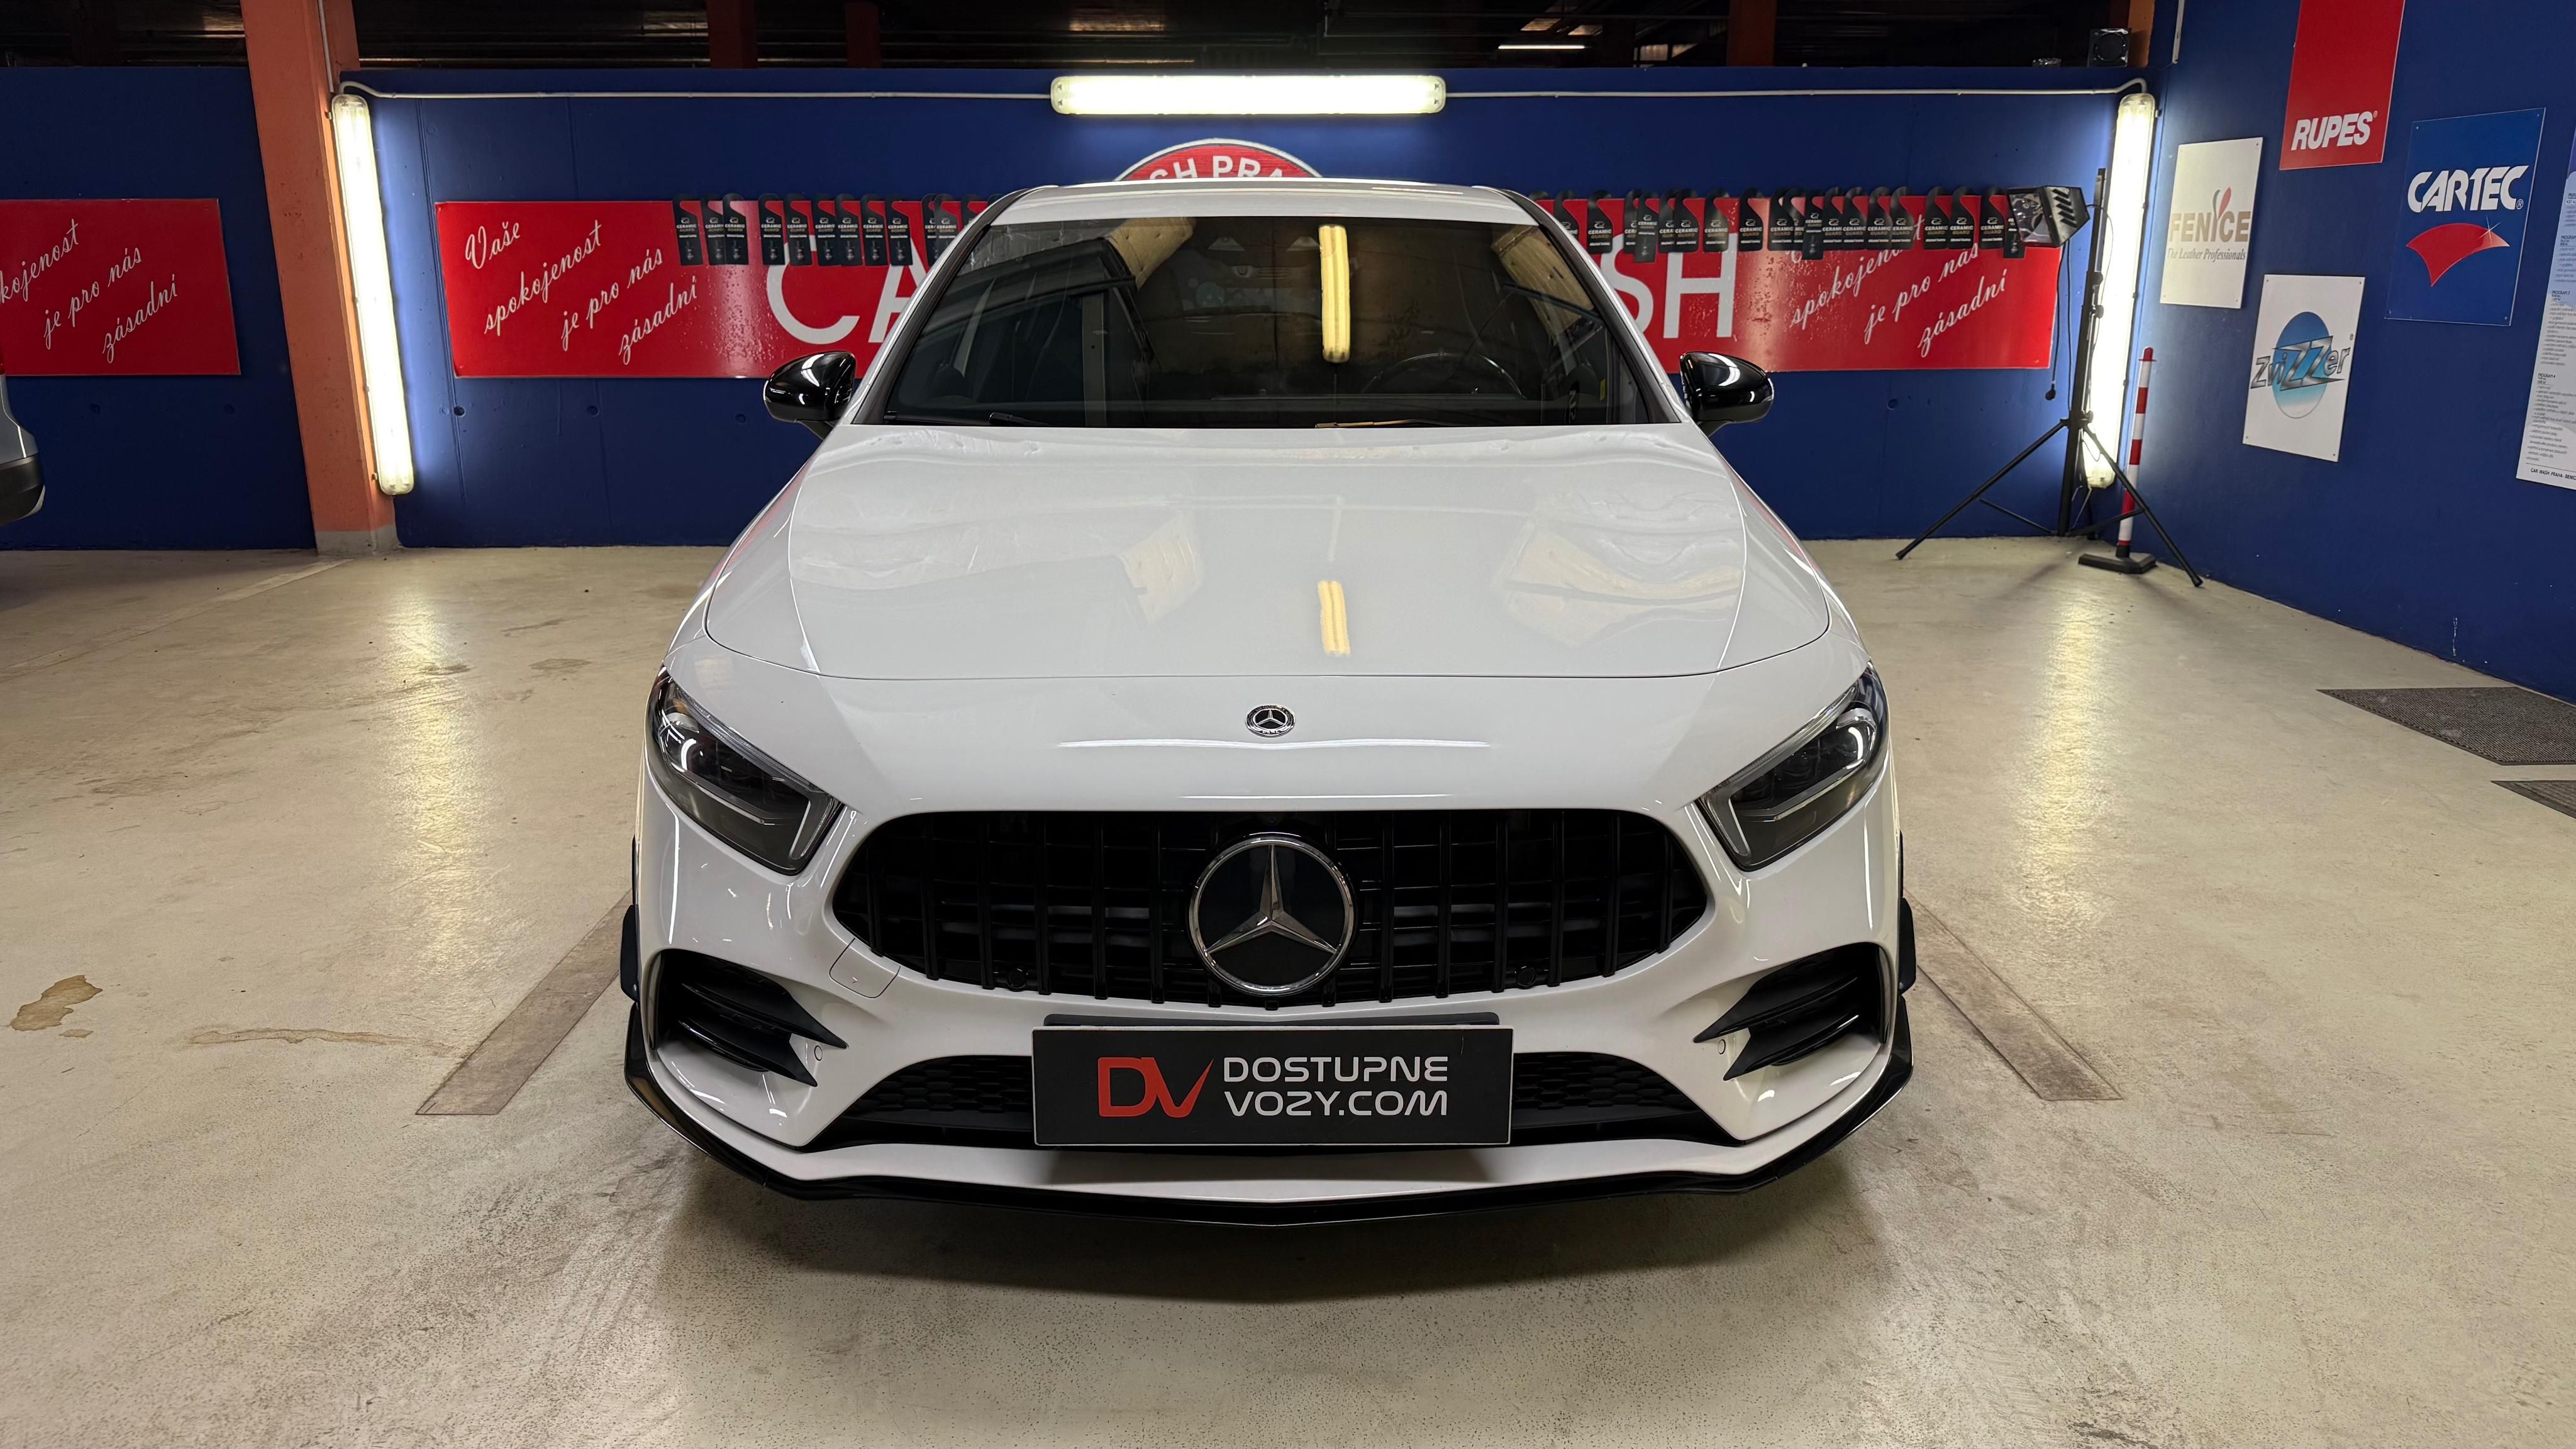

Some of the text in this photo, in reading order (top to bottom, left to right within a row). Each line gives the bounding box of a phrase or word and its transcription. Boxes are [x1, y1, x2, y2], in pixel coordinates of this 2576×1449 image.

[2290, 111, 2373, 151] RUPES
[2407, 165, 2529, 213] CARTEC
[465, 221, 521, 269] Vaše
[2169, 211, 2251, 242] FENICE
[2179, 248, 2202, 260] Leather
[2203, 248, 2246, 262] Professionals
[44, 248, 142, 350] je pro nás
[484, 219, 602, 336] spokojenost
[561, 248, 663, 352] je pro nás
[103, 274, 178, 364] zásadní
[618, 276, 697, 365] zásadní
[1864, 304, 1885, 345] je
[1892, 276, 1931, 322] pro
[1918, 269, 2007, 358] zásadní
[1224, 1056, 1448, 1082] DOSTUPNE
[1224, 1090, 1447, 1116] VOZY.COM
